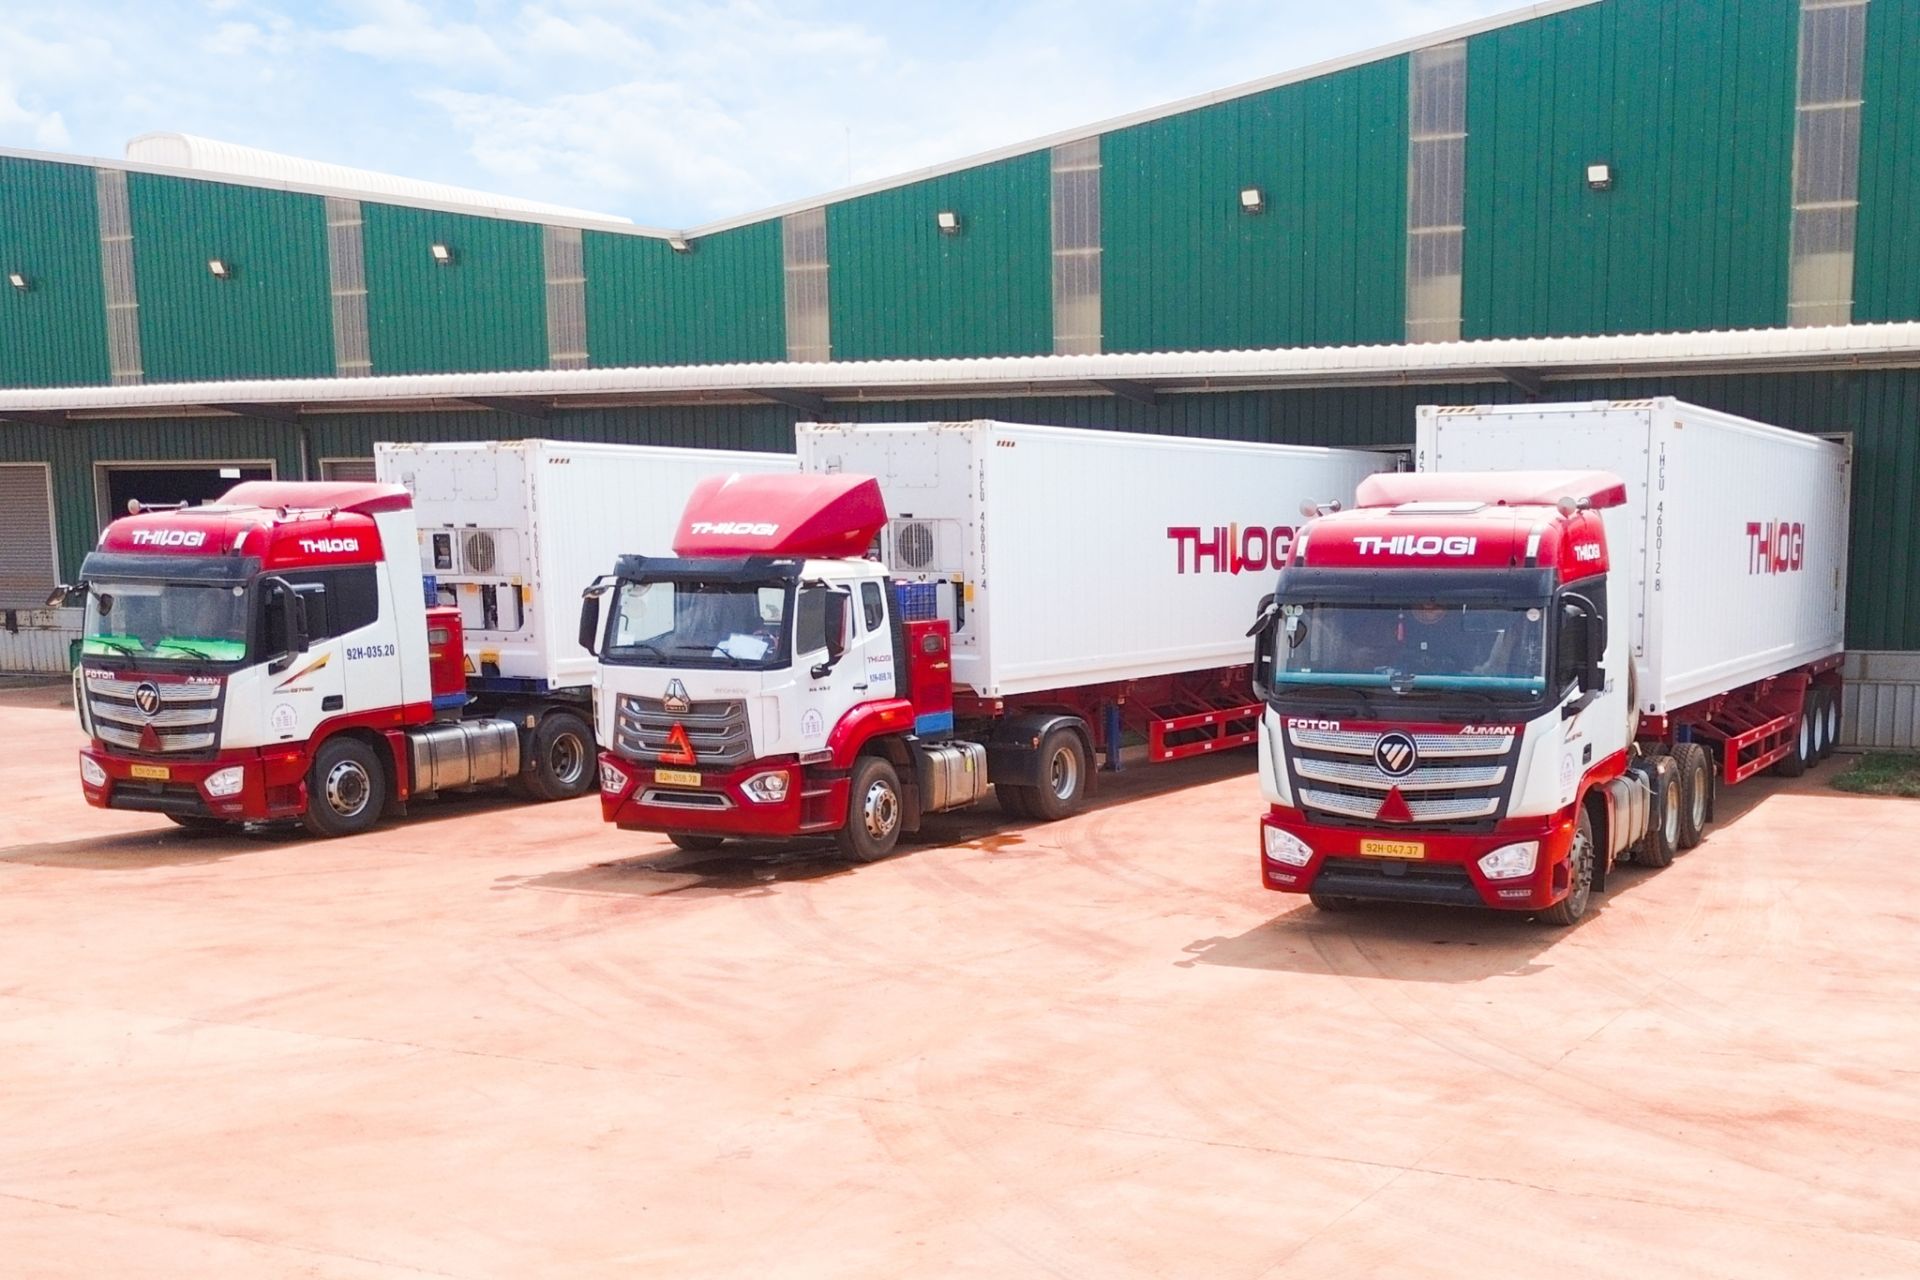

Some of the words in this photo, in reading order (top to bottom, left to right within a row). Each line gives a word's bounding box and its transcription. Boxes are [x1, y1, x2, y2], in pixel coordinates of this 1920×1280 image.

[691, 521, 779, 536] THILOGI
[132, 530, 206, 547] THILOGI
[299, 538, 358, 553] THILOGI
[1353, 535, 1476, 557] THILOGI
[1746, 517, 1804, 576] THILOGI
[1166, 522, 1301, 575] THILOG
[346, 644, 395, 660] 92H-035.20
[1288, 718, 1340, 731] FOTON
[1459, 725, 1516, 735] AUMAN
